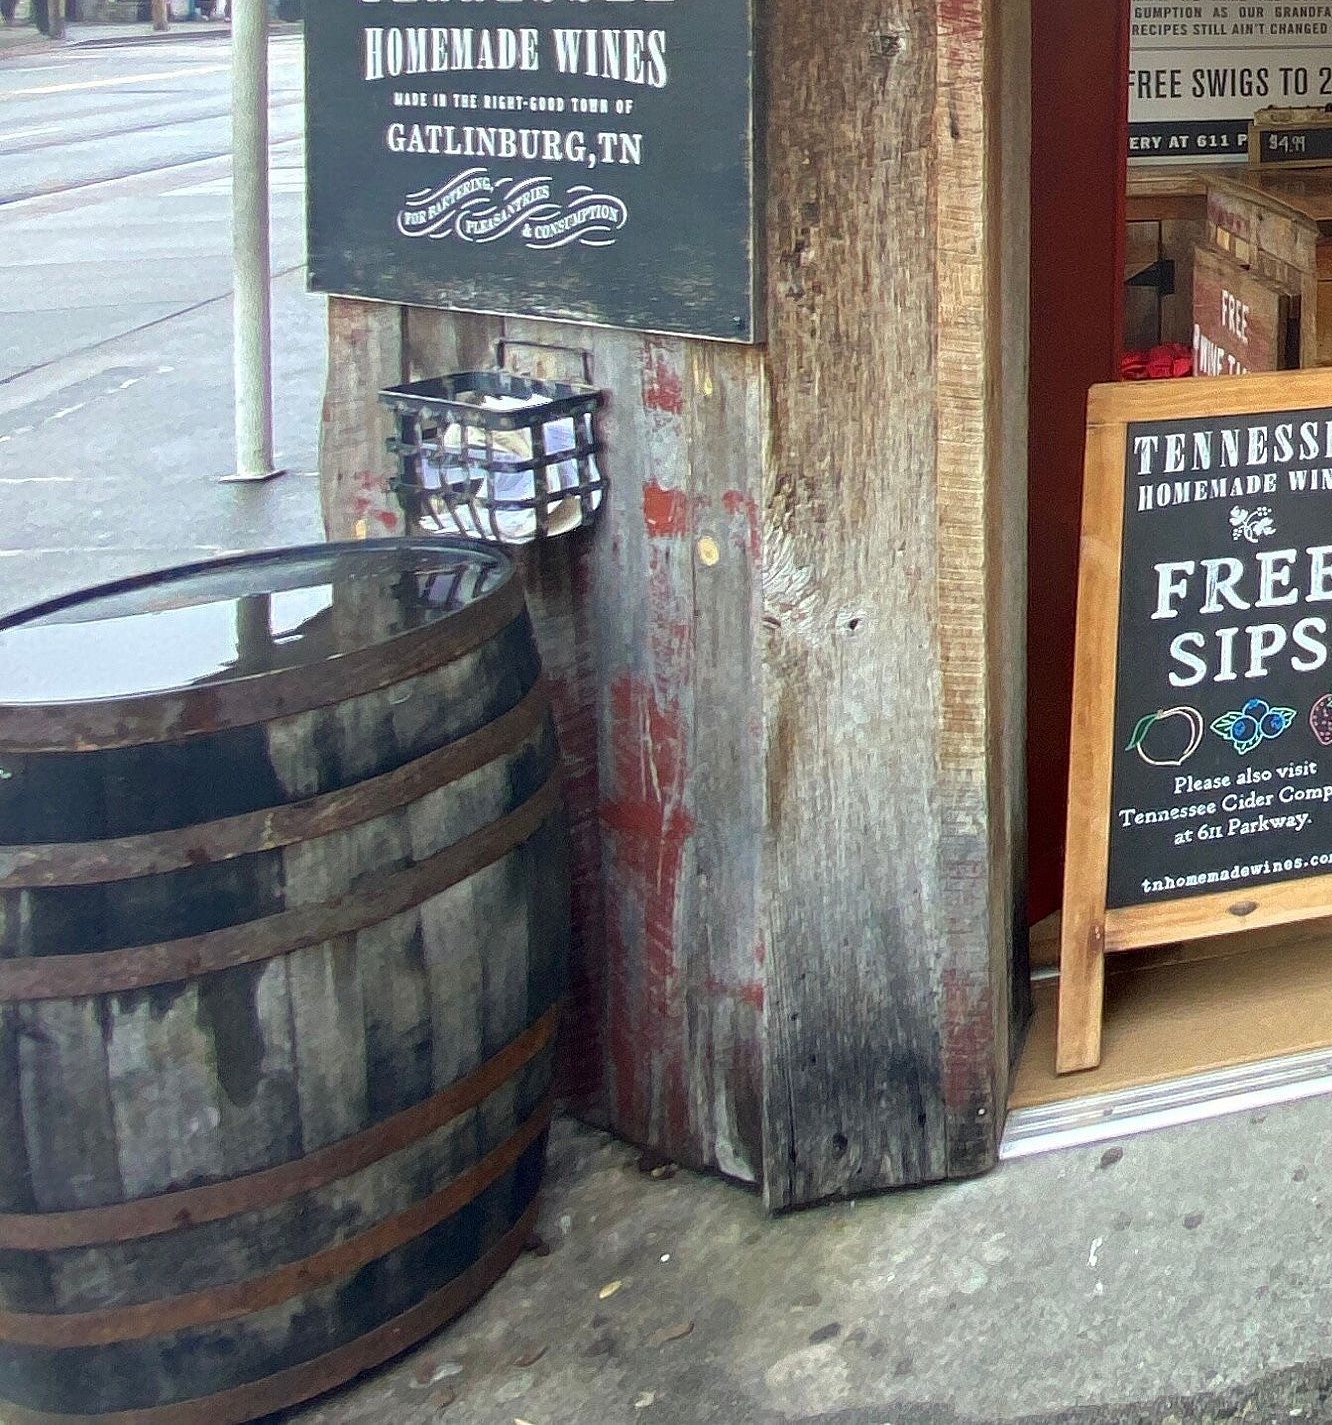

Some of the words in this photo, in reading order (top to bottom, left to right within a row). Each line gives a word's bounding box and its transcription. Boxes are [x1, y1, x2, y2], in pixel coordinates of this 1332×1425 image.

[1134, 6, 1202, 18] GUMPTION
[1213, 6, 1229, 18] AS
[1239, 6, 1264, 18] OUR
[1132, 24, 1187, 36] RECIPES
[1193, 23, 1227, 35] STILL
[1232, 23, 1265, 35] AIN'T
[1270, 23, 1327, 35] CHANGED
[364, 28, 539, 80] HOMEMADE
[552, 28, 668, 89] WINES
[1128, 69, 1181, 99] FREE
[1192, 68, 1269, 98] SWIGS
[1279, 67, 1308, 95] TO
[394, 92, 428, 107] MADE
[433, 93, 447, 108] IN
[453, 94, 477, 109] THE
[483, 95, 565, 112] RIGHT-GOOD
[572, 97, 608, 114] TOWN
[616, 99, 634, 115] OF
[1169, 135, 1189, 149] AT
[1197, 134, 1230, 147] 611
[403, 210, 427, 225] FOR
[427, 176, 494, 219] BARTERING,
[465, 184, 550, 234] PLEASANTRIES
[522, 223, 532, 238] &
[534, 204, 619, 239] CONSUMPTION
[1222, 289, 1249, 345] FREE
[1137, 473, 1277, 512] HOMEMADE
[1168, 617, 1327, 687] SIPS
[1174, 776, 1231, 794] Please
[1236, 768, 1272, 784] also
[1276, 761, 1317, 778] visit
[1119, 802, 1217, 827] Tennessee
[1222, 791, 1274, 811] Cider
[1174, 830, 1194, 845] at
[1198, 824, 1223, 841] 611
[1227, 812, 1313, 836] Parkway.
